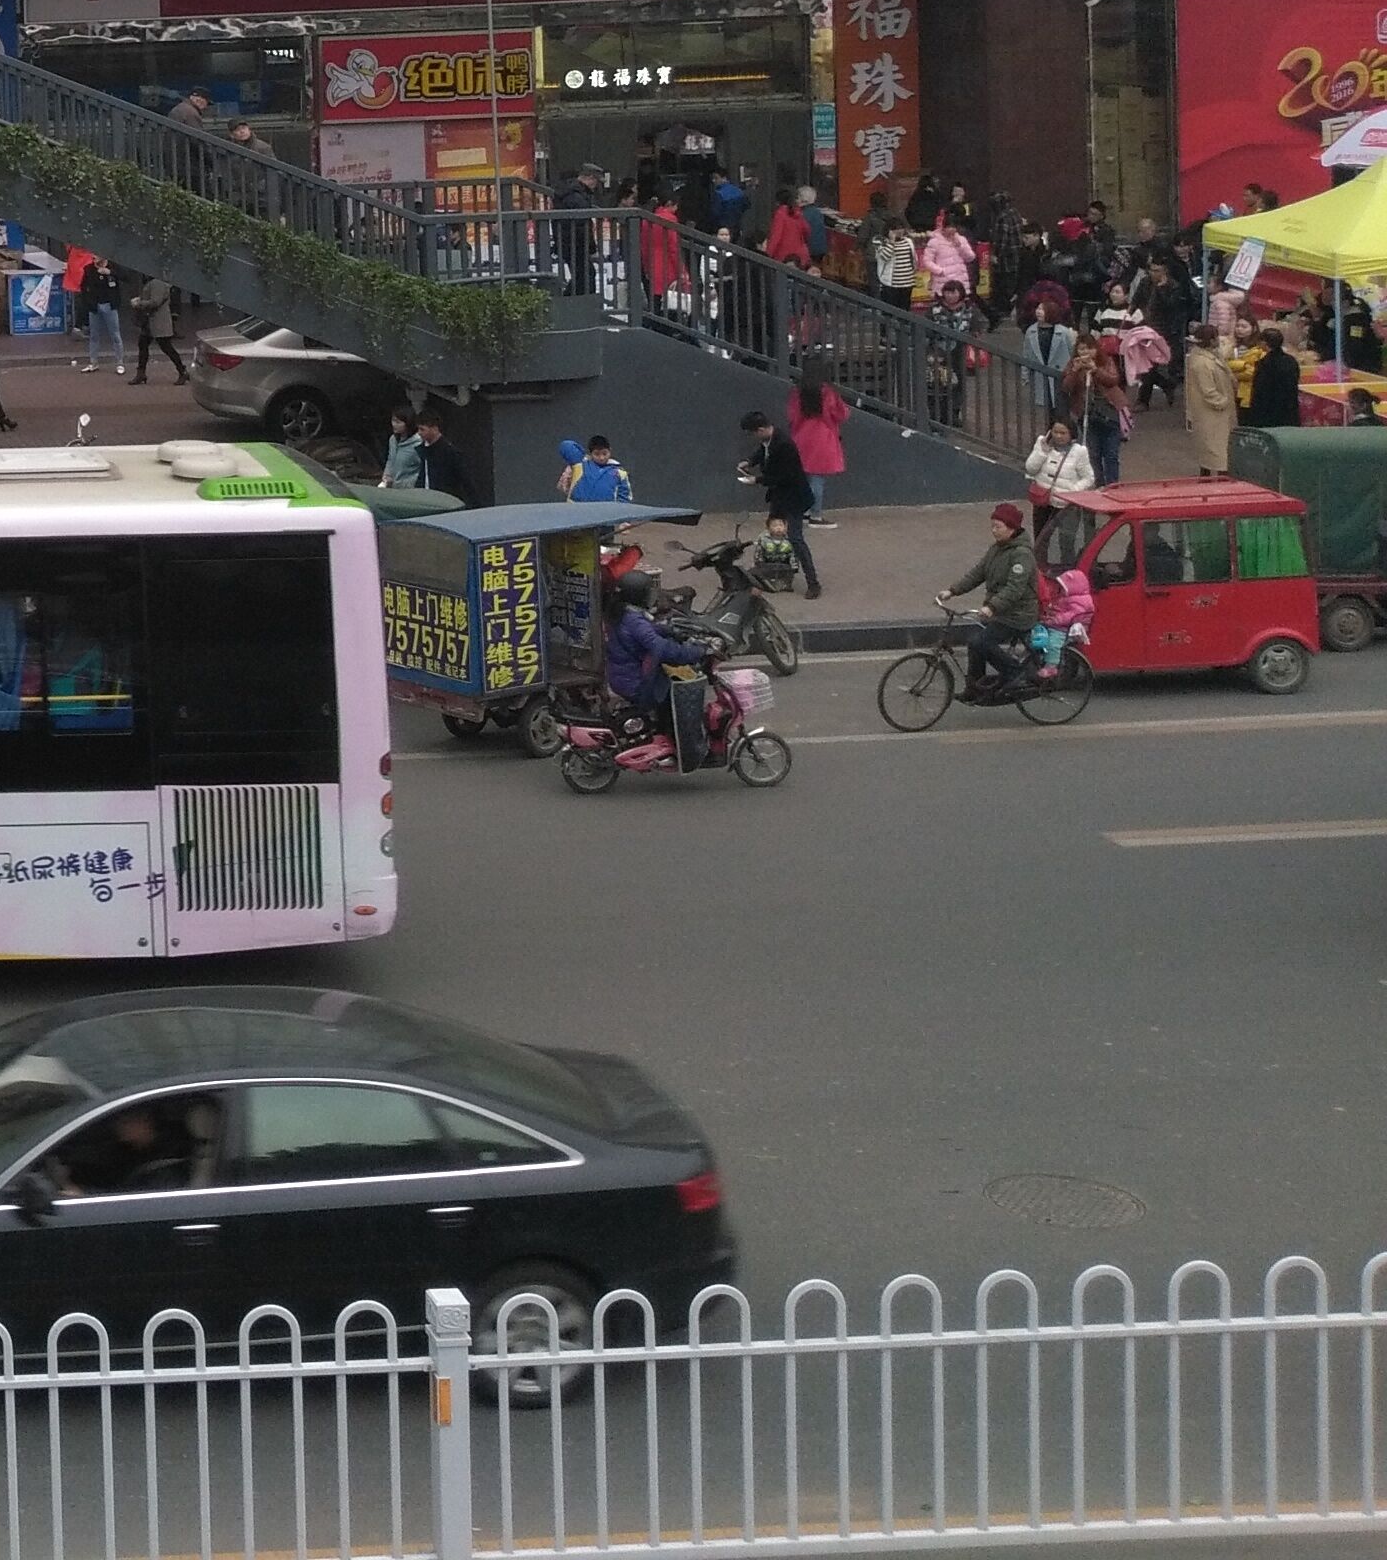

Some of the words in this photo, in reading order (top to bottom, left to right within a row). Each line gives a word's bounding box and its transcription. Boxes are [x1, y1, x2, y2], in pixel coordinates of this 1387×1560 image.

[384, 617, 470, 666] 7575757
[482, 545, 515, 690] 电脑上门维修
[511, 541, 540, 686] 7575757
